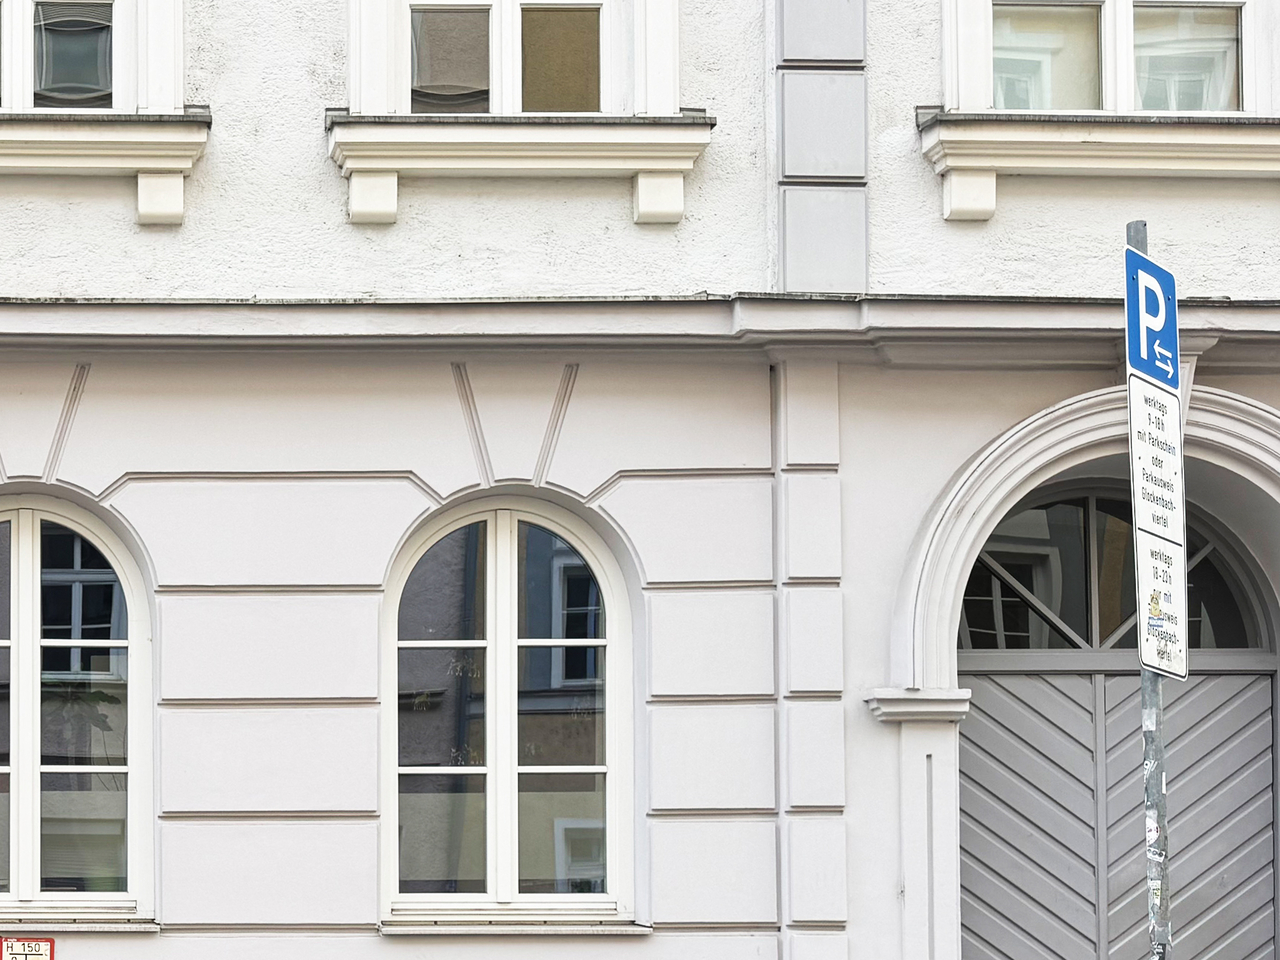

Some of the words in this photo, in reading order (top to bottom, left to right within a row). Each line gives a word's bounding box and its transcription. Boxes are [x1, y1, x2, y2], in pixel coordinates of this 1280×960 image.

[1138, 268, 1166, 360] P
[1144, 394, 1167, 416] werktags
[1137, 430, 1147, 444] mit
[1148, 432, 1176, 456] Parkschein
[1152, 455, 1164, 469] oder
[1142, 467, 1174, 493] Parkausweis
[1141, 487, 1177, 511] Glockenbach-
[1151, 512, 1169, 529] viertel
[1150, 548, 1173, 568] werktags
[1164, 591, 1172, 604] mit
[6, 942, 14, 952] H
[21, 942, 41, 953] 150
